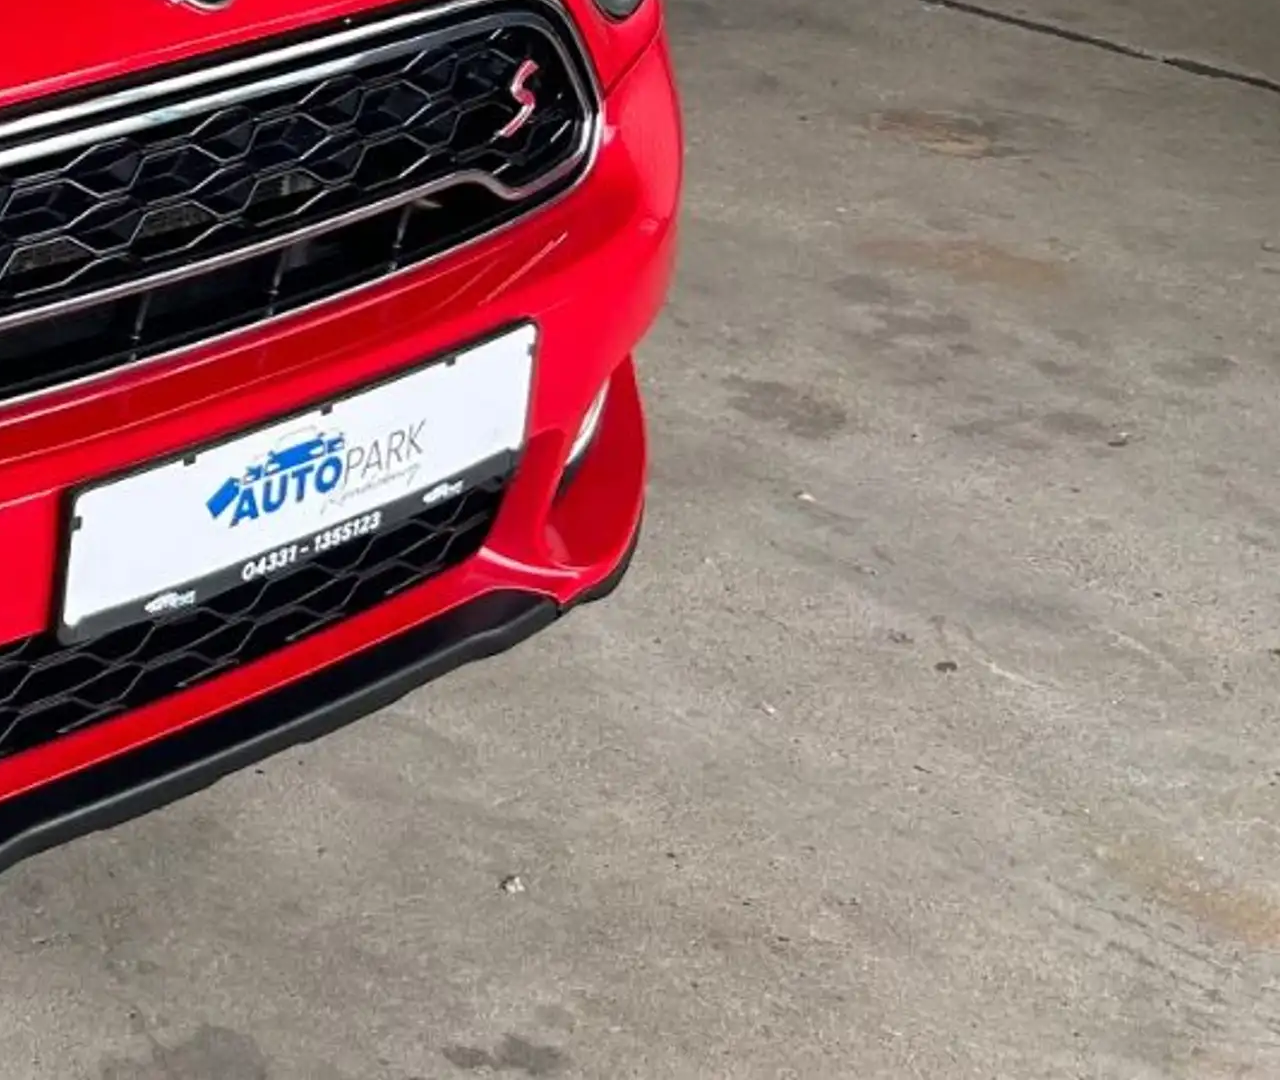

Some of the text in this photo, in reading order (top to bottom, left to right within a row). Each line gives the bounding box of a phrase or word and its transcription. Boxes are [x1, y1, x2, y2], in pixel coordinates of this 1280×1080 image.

[229, 418, 427, 528] AUTOPARK
[242, 544, 298, 582] 04331
[314, 510, 382, 553] 1355123
